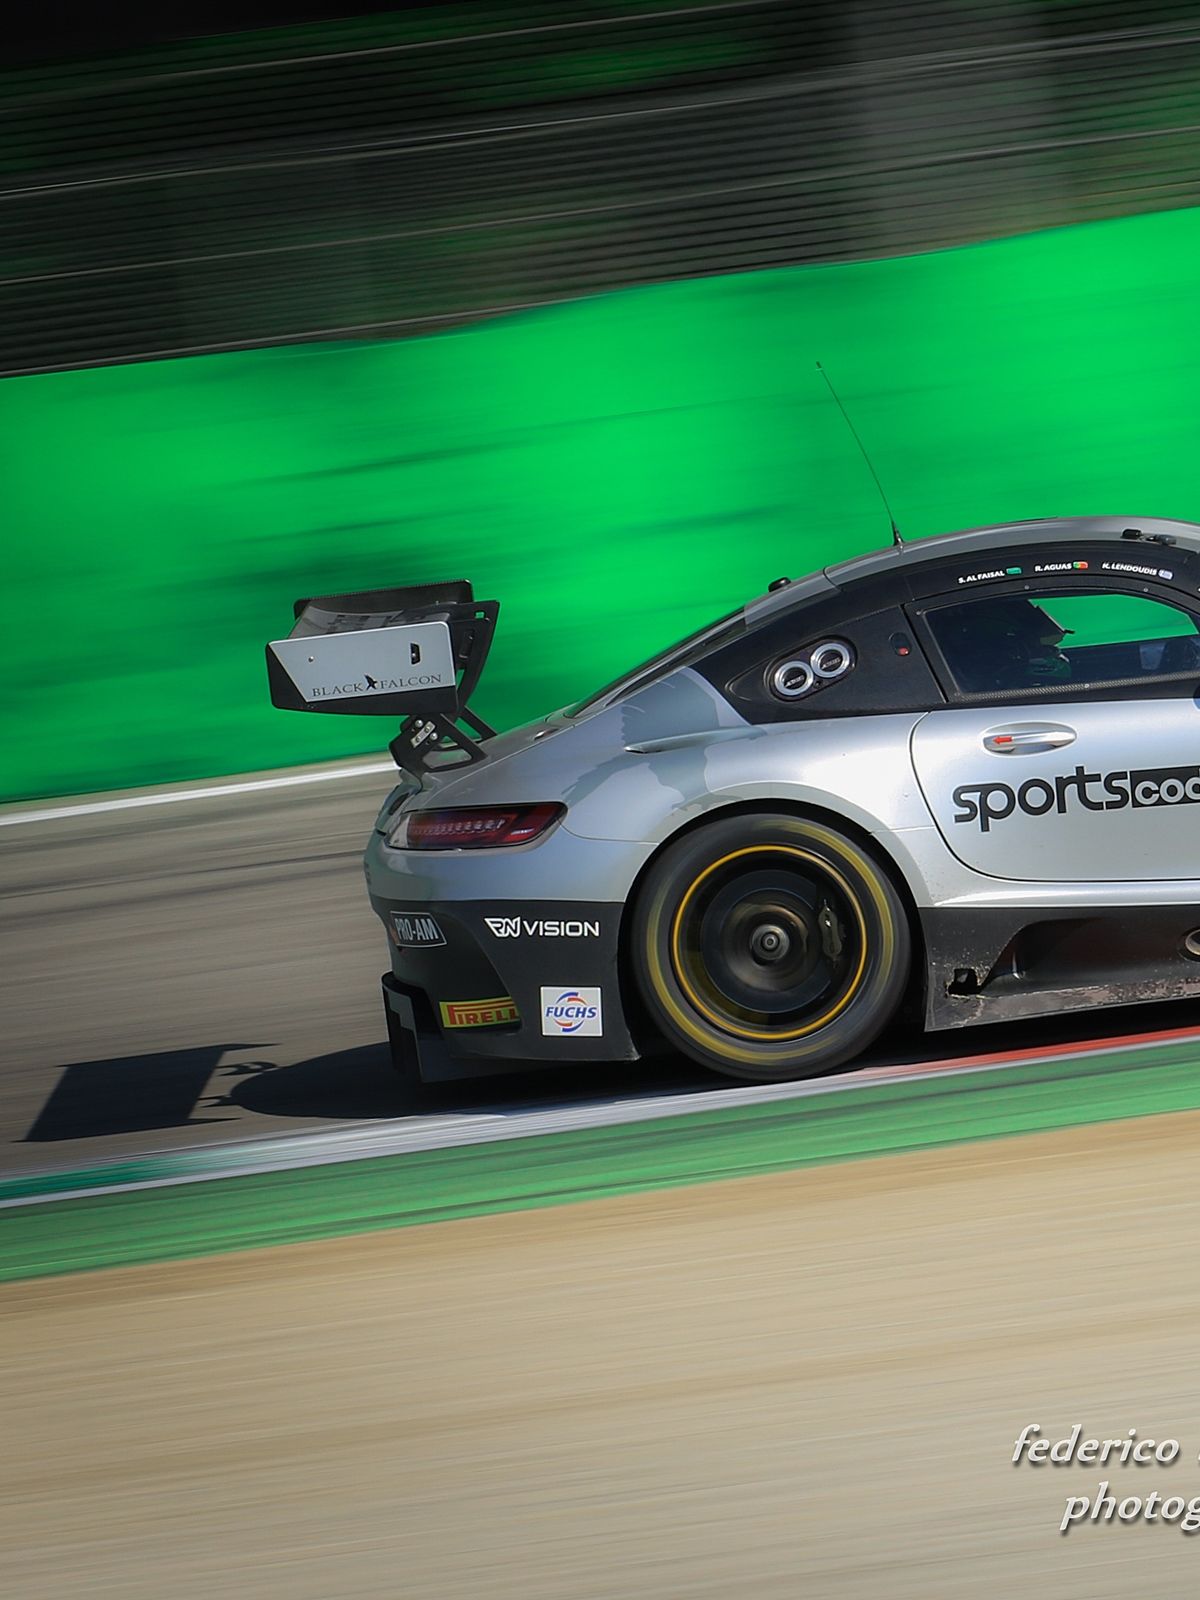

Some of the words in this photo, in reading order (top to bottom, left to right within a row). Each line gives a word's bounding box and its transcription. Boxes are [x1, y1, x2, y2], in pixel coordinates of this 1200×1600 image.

[1043, 562, 1072, 571] AGUAS
[977, 570, 1005, 581] FAISAL
[312, 682, 365, 698] BLACK
[378, 674, 442, 690] FALCON
[395, 918, 439, 941] PRO-AM
[523, 921, 599, 937] VISION
[545, 1006, 597, 1019] FUCHS
